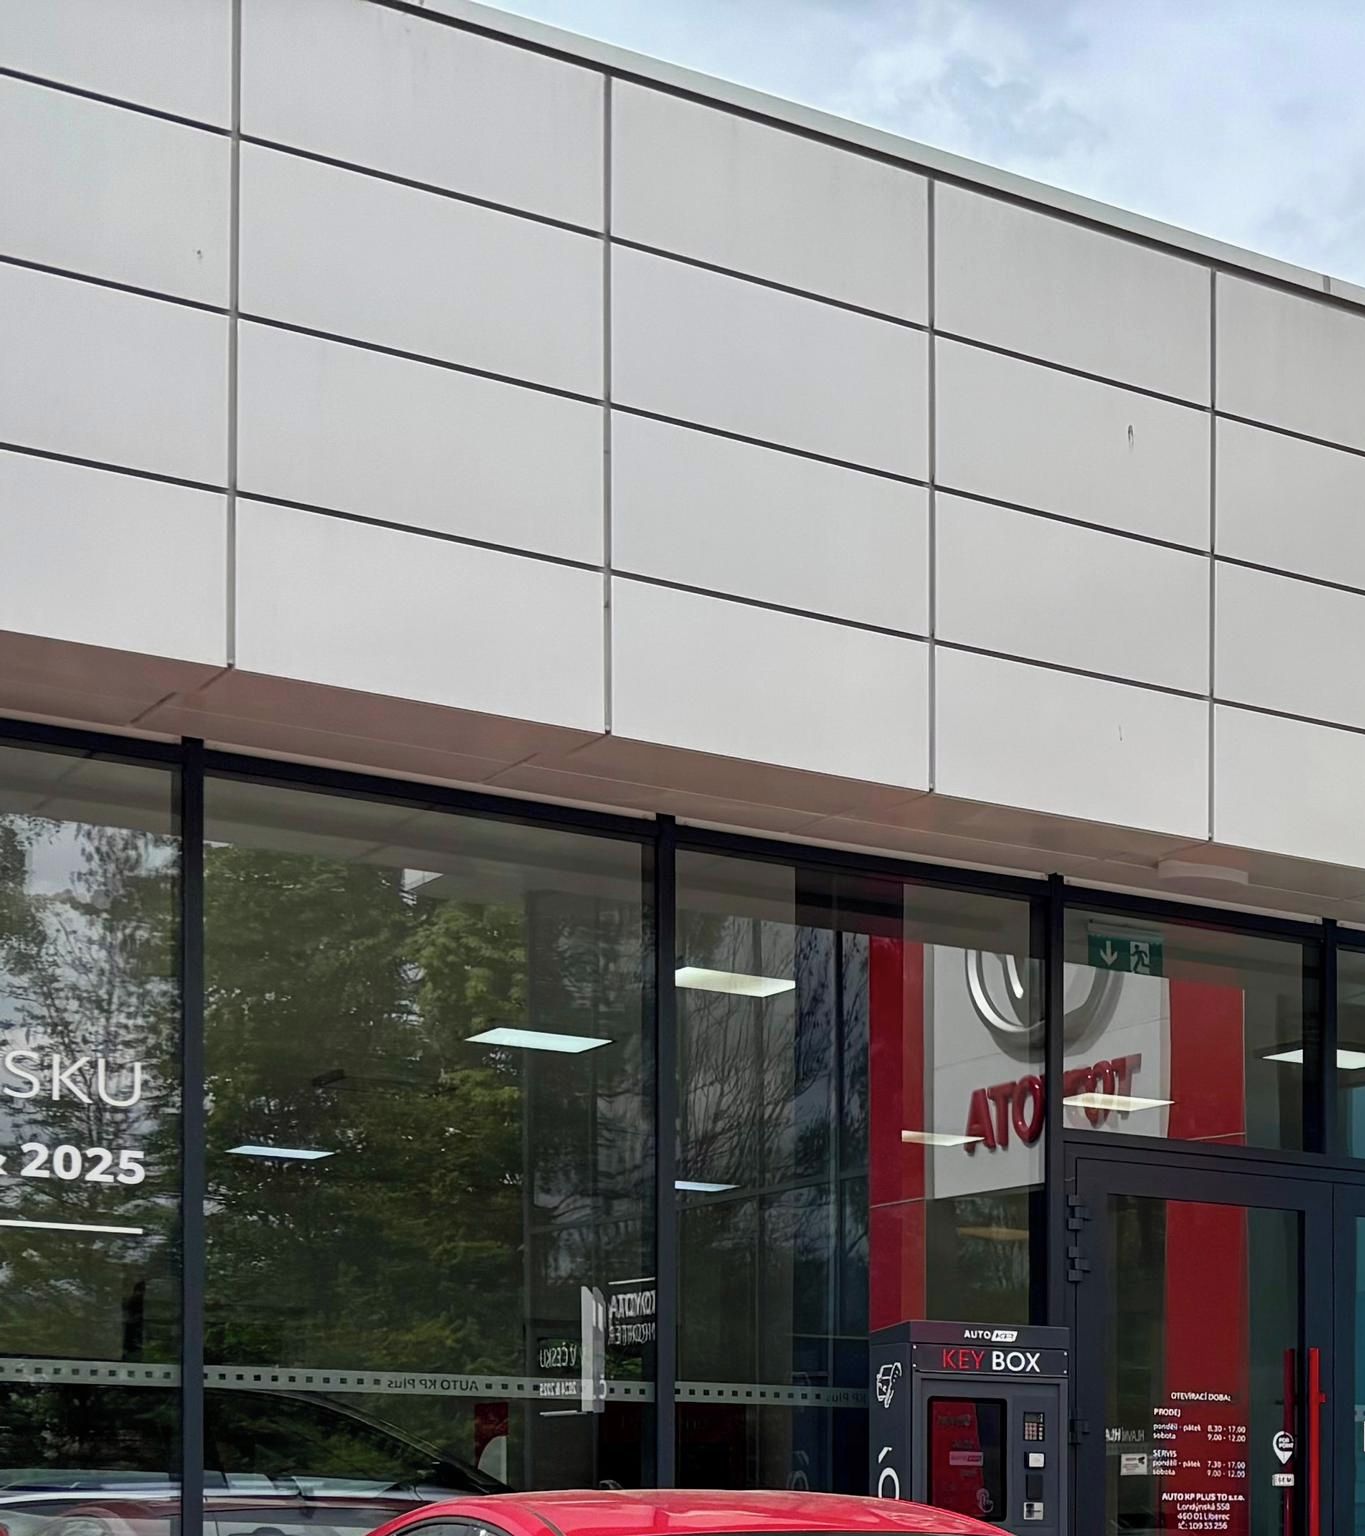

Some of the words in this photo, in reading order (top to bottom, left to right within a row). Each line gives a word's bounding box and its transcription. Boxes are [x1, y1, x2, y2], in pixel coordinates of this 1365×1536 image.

[20, 1142, 145, 1184] 2025
[964, 1330, 991, 1339] AUTO
[943, 1349, 985, 1369] KEY
[992, 1351, 1040, 1372] BOX
[1162, 1492, 1183, 1501] AUTO
[1196, 1493, 1216, 1501] PLUS
